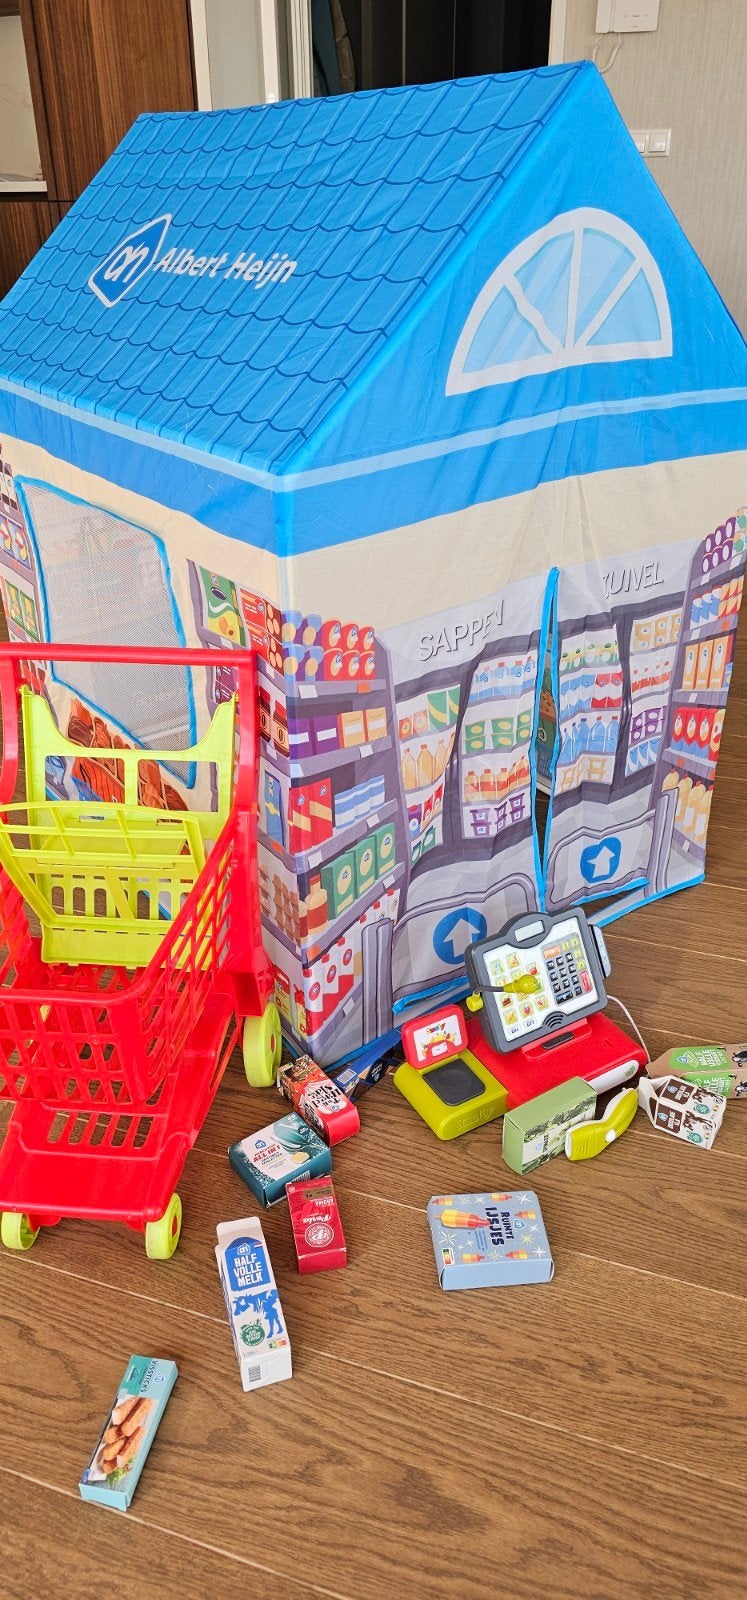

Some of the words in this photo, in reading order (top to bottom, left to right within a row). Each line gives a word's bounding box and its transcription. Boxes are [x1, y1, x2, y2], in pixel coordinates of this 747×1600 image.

[153, 247, 229, 278] Albert
[223, 251, 298, 290] Heijn
[253, 1151, 268, 1163] ALL
[485, 1206, 505, 1246] IJSJES
[500, 1211, 514, 1240] RUIMTE
[233, 1253, 257, 1268] HALF
[233, 1261, 263, 1278] VOLLE
[237, 1271, 263, 1288] MELK
[140, 1360, 157, 1393] VISSTICKS
